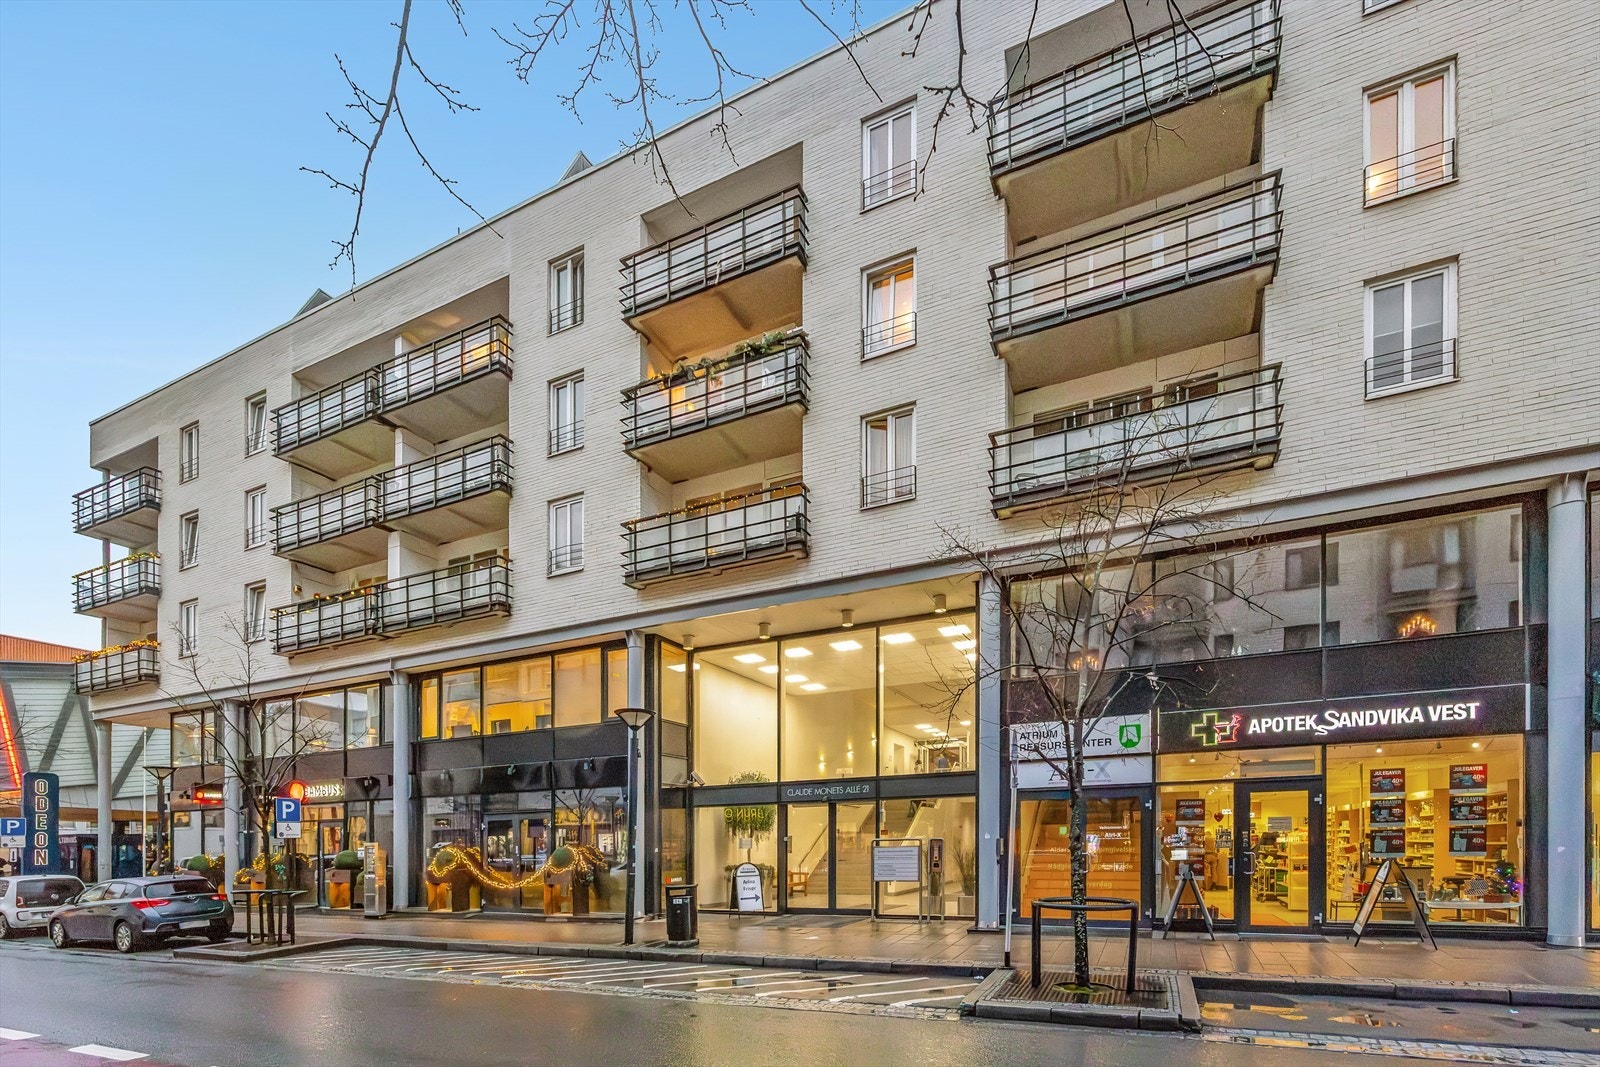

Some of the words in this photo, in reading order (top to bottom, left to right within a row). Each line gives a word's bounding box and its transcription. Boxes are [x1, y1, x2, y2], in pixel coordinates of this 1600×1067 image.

[1248, 714, 1316, 734] APOTEK
[1315, 706, 1425, 736] SANDVIKA
[1427, 702, 1481, 722] VEST
[1019, 730, 1058, 740] ATRIUM
[787, 787, 813, 797] CLAUDE
[814, 786, 844, 796] MONETS
[845, 784, 861, 794] ALLÉ
[862, 784, 870, 793] 21
[282, 801, 295, 819] P
[6, 820, 20, 834] P
[34, 778, 49, 866] ODEON
